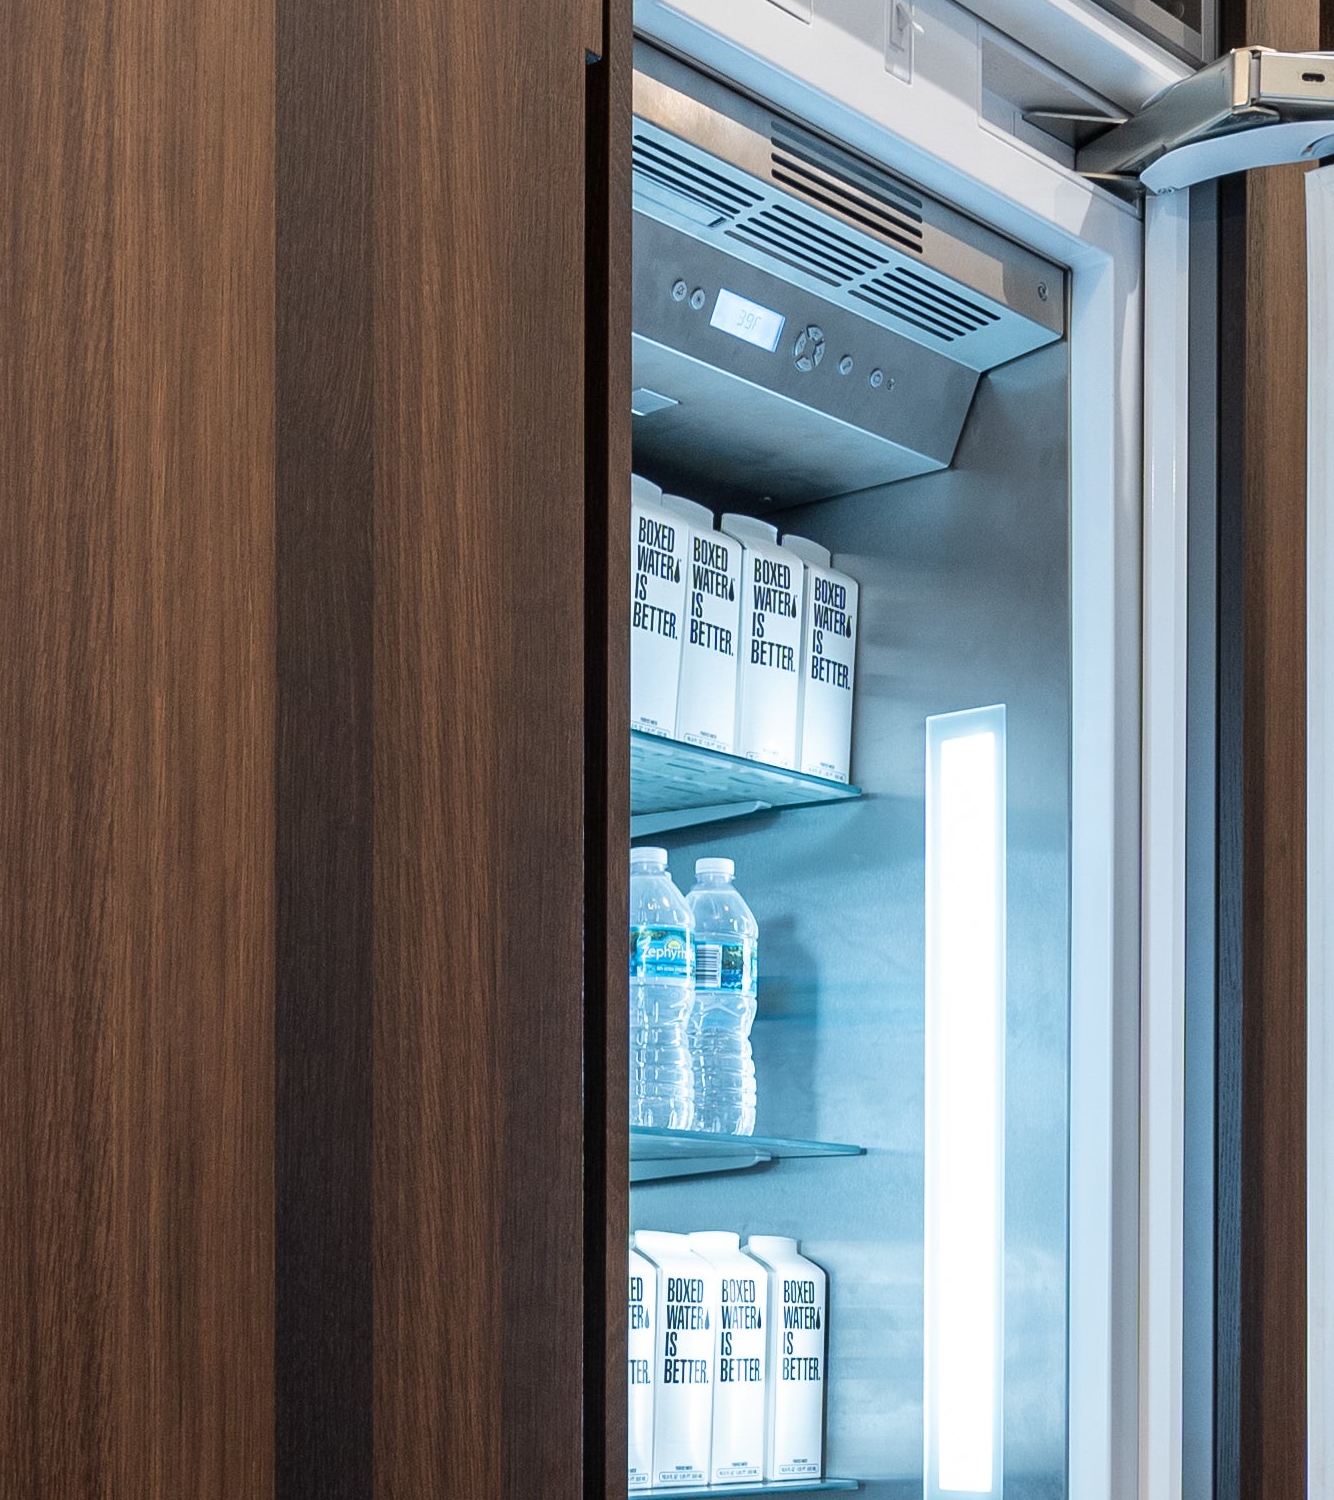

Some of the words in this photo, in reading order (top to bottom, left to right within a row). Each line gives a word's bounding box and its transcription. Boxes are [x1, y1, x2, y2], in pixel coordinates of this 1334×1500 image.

[639, 516, 675, 553] BOXED
[637, 545, 674, 582] WATER
[693, 537, 728, 572] BOXED
[634, 574, 647, 600] IS
[692, 564, 728, 600] WATER
[753, 558, 791, 590] BOXED
[691, 592, 703, 618] IS
[753, 585, 791, 617] WATER
[814, 577, 846, 609] BOXED
[632, 606, 678, 640] BETTER.
[752, 612, 764, 638] IS
[814, 603, 846, 636] WATER
[689, 622, 734, 656] BETTER.
[812, 629, 823, 655] IS
[750, 639, 795, 672] BETTER.
[811, 655, 851, 690] BETTER.
[667, 1277, 704, 1303] BOXED
[722, 1279, 755, 1303] BOXED
[783, 1280, 814, 1304] BOXED
[667, 1305, 704, 1330] WATER
[721, 1306, 757, 1330] WATER
[783, 1306, 816, 1329] WATER
[665, 1332, 677, 1356] IS
[720, 1332, 732, 1356] IS
[782, 1332, 793, 1355] IS
[629, 1359, 651, 1384] TER.
[664, 1360, 709, 1384] BETTER.
[720, 1358, 762, 1382] BETTER.
[782, 1358, 820, 1381] BETTER.
